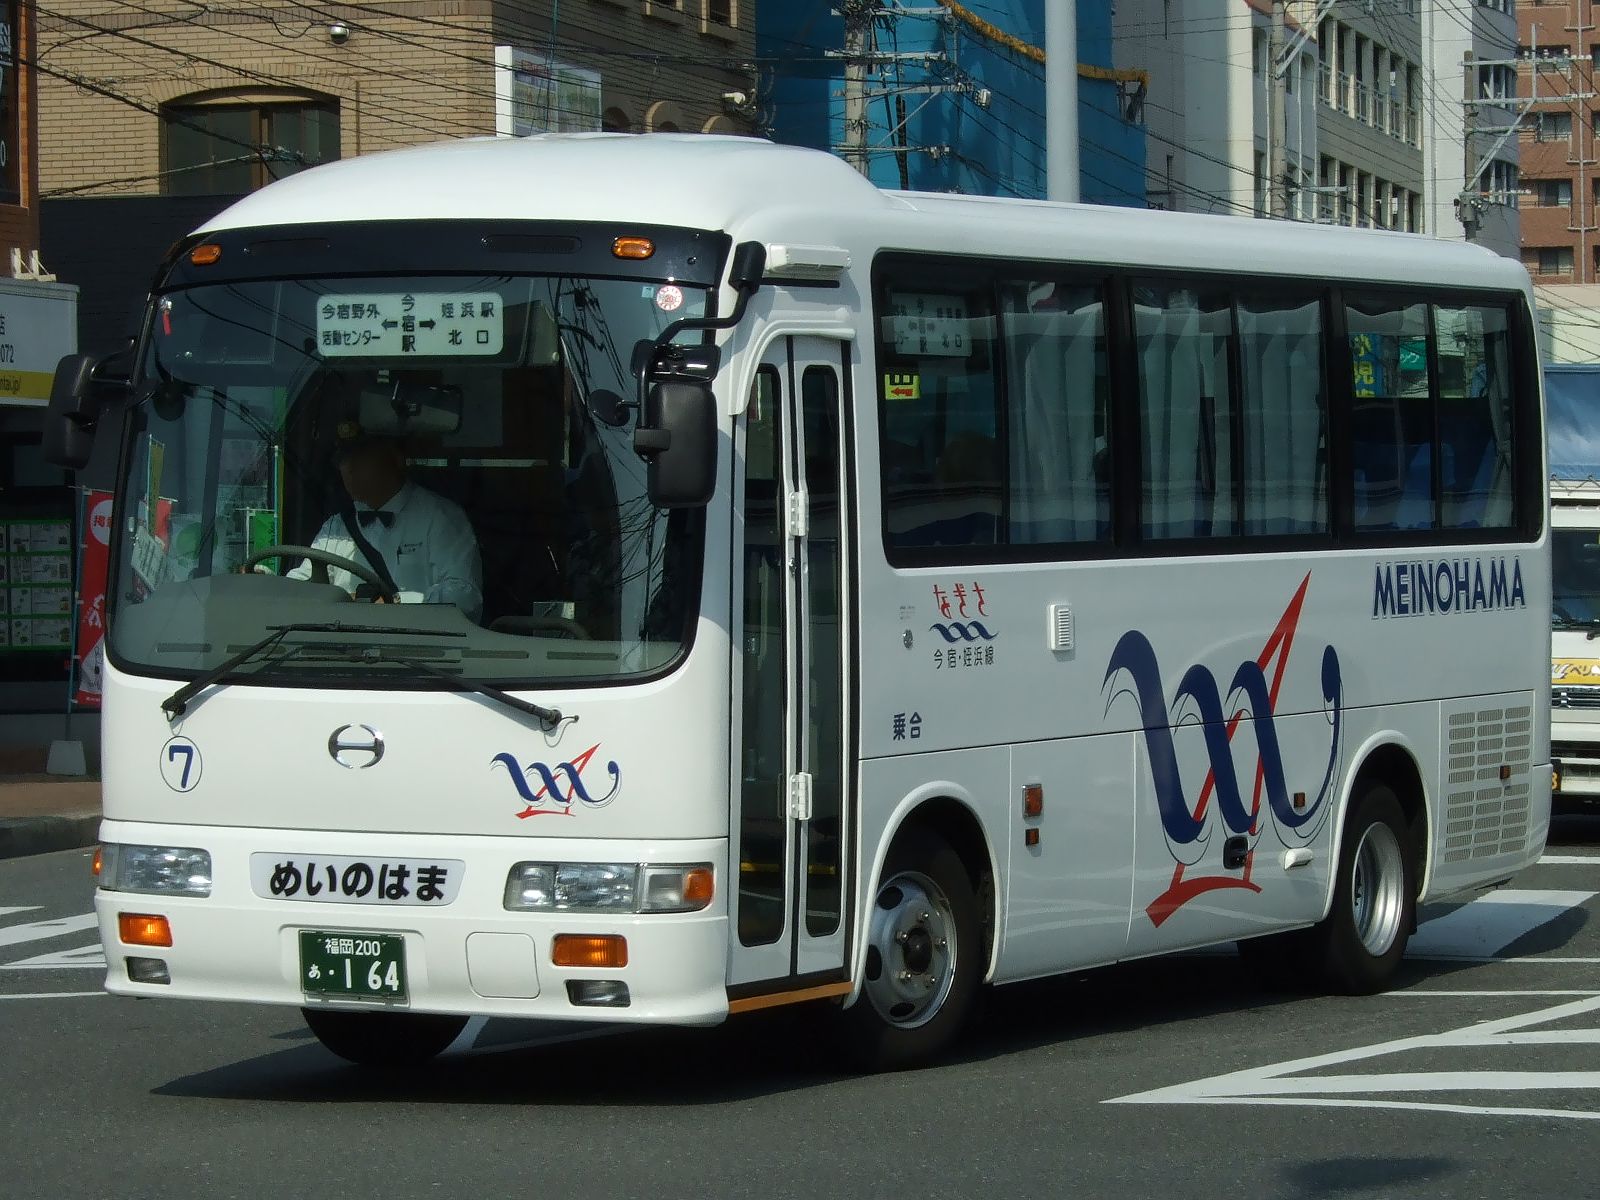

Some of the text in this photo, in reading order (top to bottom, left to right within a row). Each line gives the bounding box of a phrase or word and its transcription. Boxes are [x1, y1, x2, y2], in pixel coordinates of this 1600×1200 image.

[322, 303, 380, 320] 今宿野外
[401, 293, 416, 352] 今宿駅
[441, 302, 495, 318] 姪浜駅
[322, 330, 381, 346] 活動センター
[448, 329, 489, 345] 北口
[933, 582, 989, 619] なぎさ
[1372, 556, 1526, 619] MEINOHAMA
[893, 711, 922, 740] 乗合
[169, 745, 193, 788] 7
[270, 861, 448, 901] めいのはま
